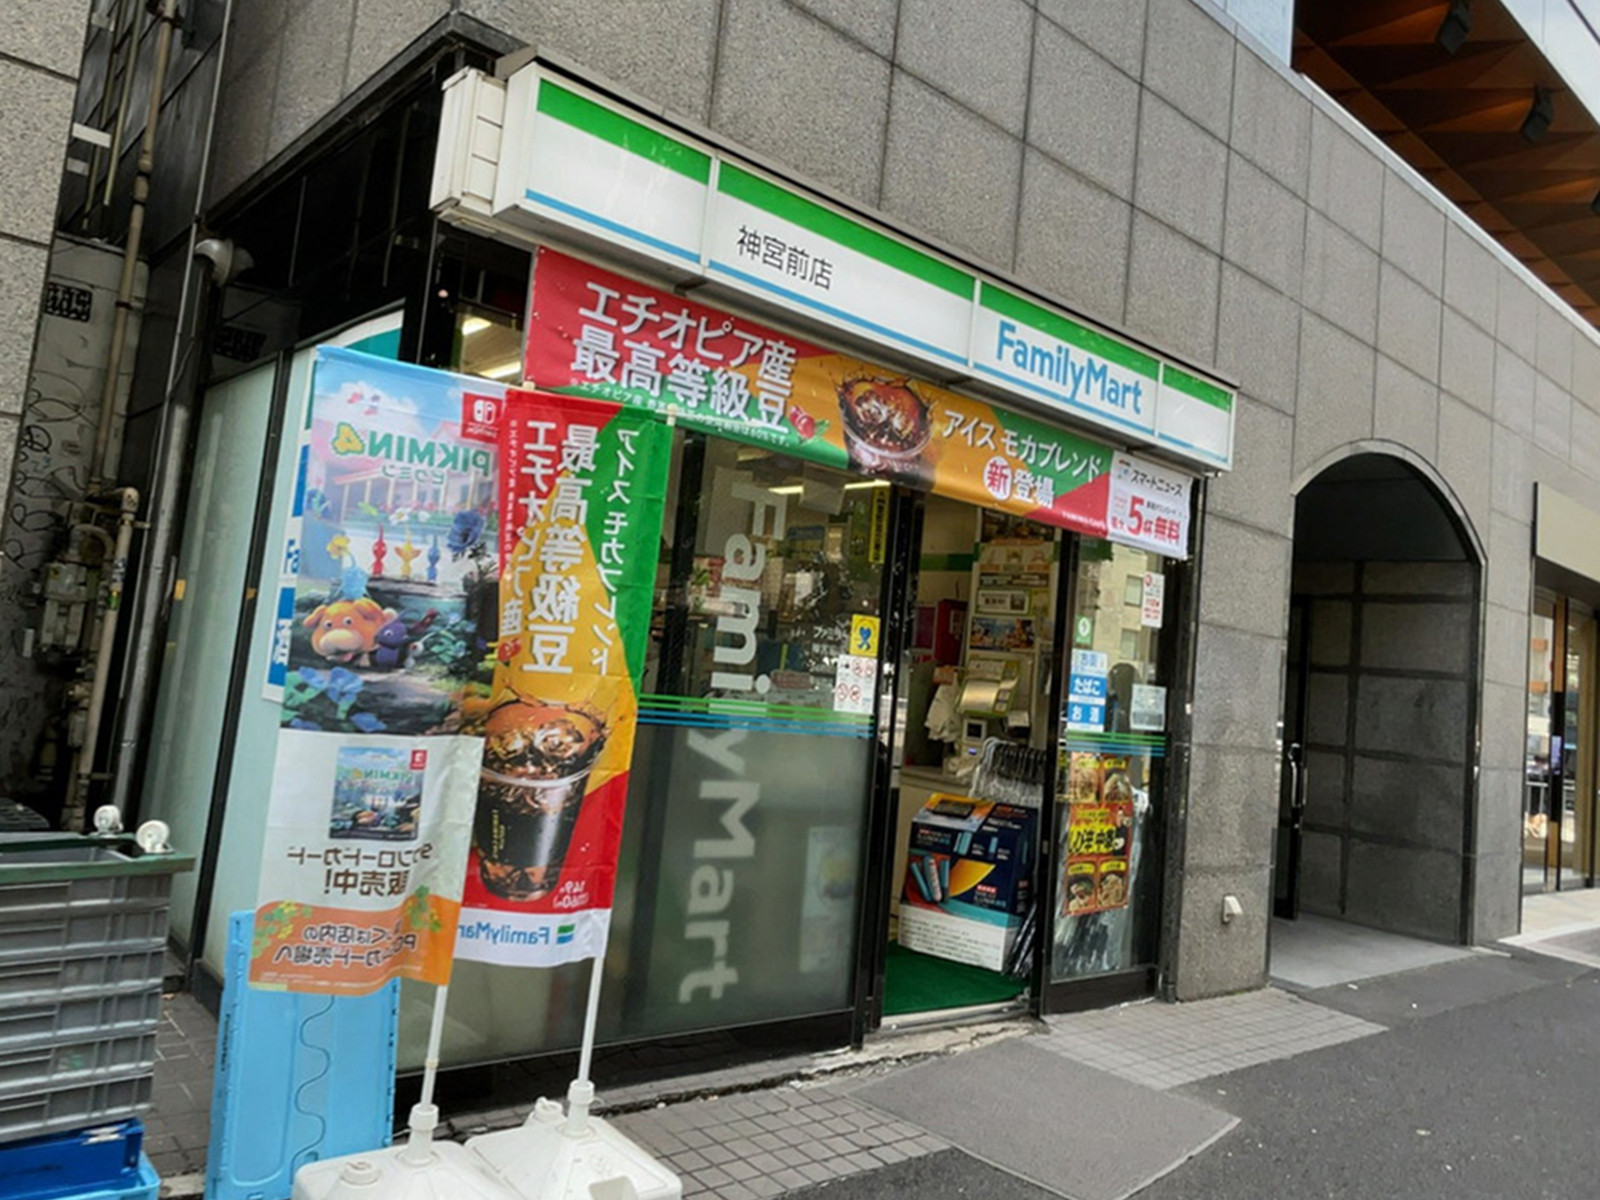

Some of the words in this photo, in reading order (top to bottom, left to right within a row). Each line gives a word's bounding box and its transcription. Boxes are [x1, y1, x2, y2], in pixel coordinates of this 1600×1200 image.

[737, 225, 833, 290] 神宮前店
[570, 323, 792, 434] 最高等級豆
[578, 281, 797, 387] エチオピア産
[996, 320, 1142, 414] FamilyMart
[942, 409, 997, 451] アイス
[1001, 429, 1104, 484] モカブレンド
[1131, 469, 1183, 497] スマートニュース
[679, 481, 788, 1003] FamilyMart
